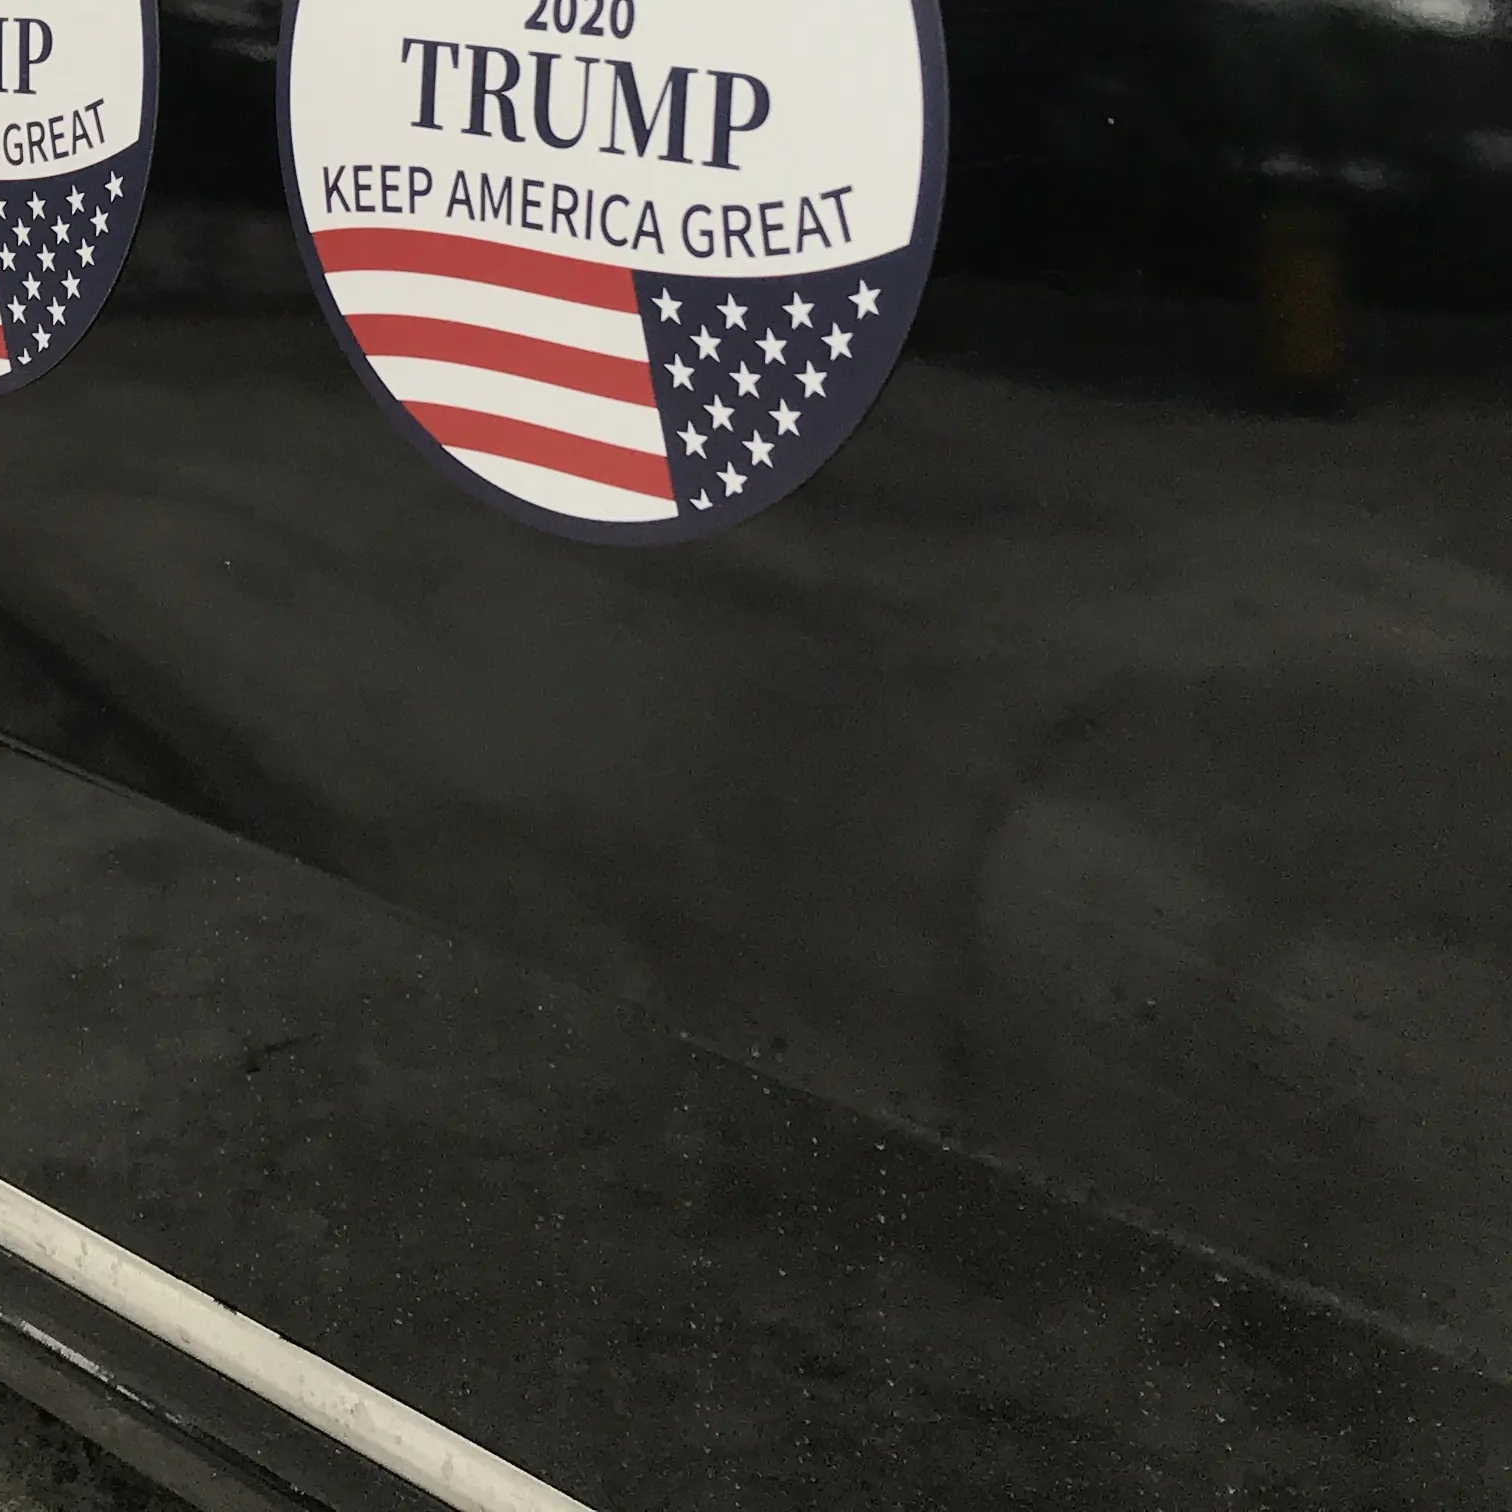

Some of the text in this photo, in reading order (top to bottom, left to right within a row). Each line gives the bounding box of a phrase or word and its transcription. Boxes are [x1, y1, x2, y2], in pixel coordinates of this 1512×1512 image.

[2, 98, 105, 167] GREAT
[401, 37, 771, 171] TRUMP
[322, 164, 853, 259] KEEP AMERICA GREAT
